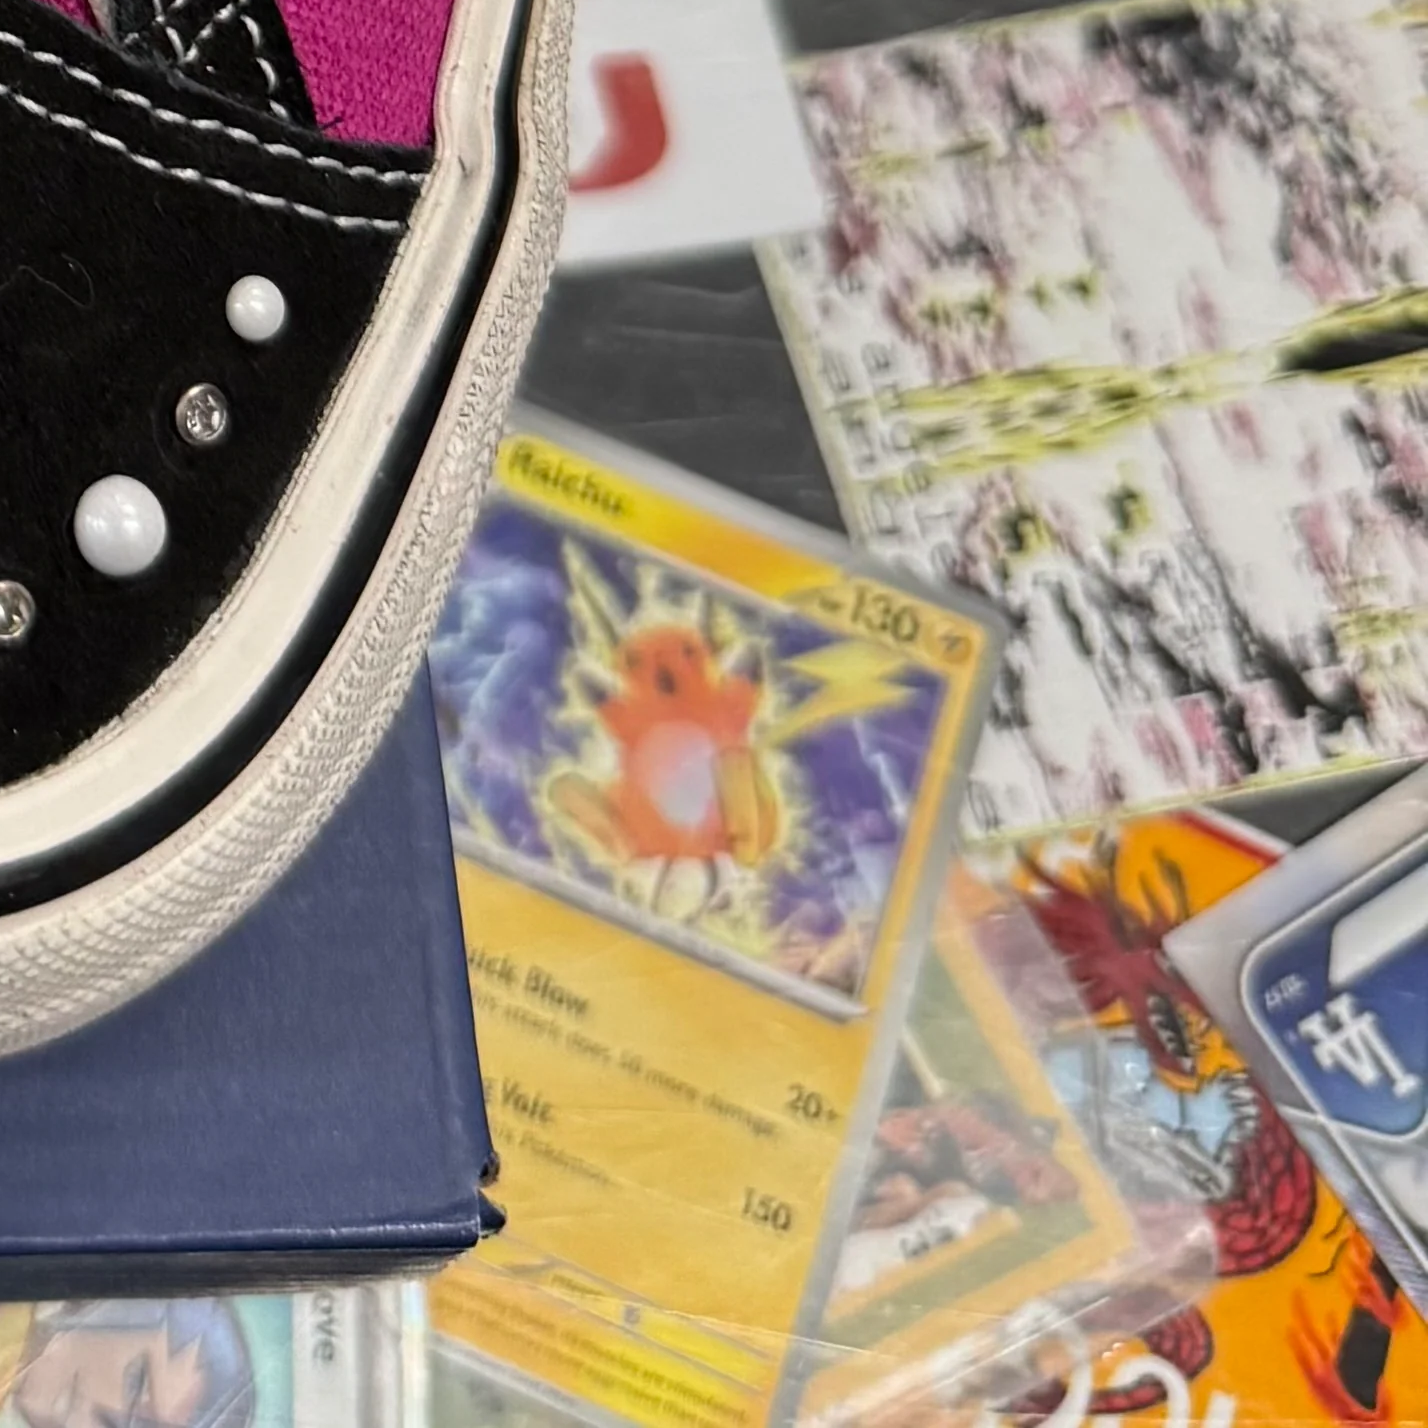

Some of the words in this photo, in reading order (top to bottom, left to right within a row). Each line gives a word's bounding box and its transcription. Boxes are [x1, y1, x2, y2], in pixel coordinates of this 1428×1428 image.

[506, 440, 634, 520] Raichu
[848, 585, 920, 644] 130
[523, 966, 590, 1016] Blow
[740, 1186, 794, 1235] 150
